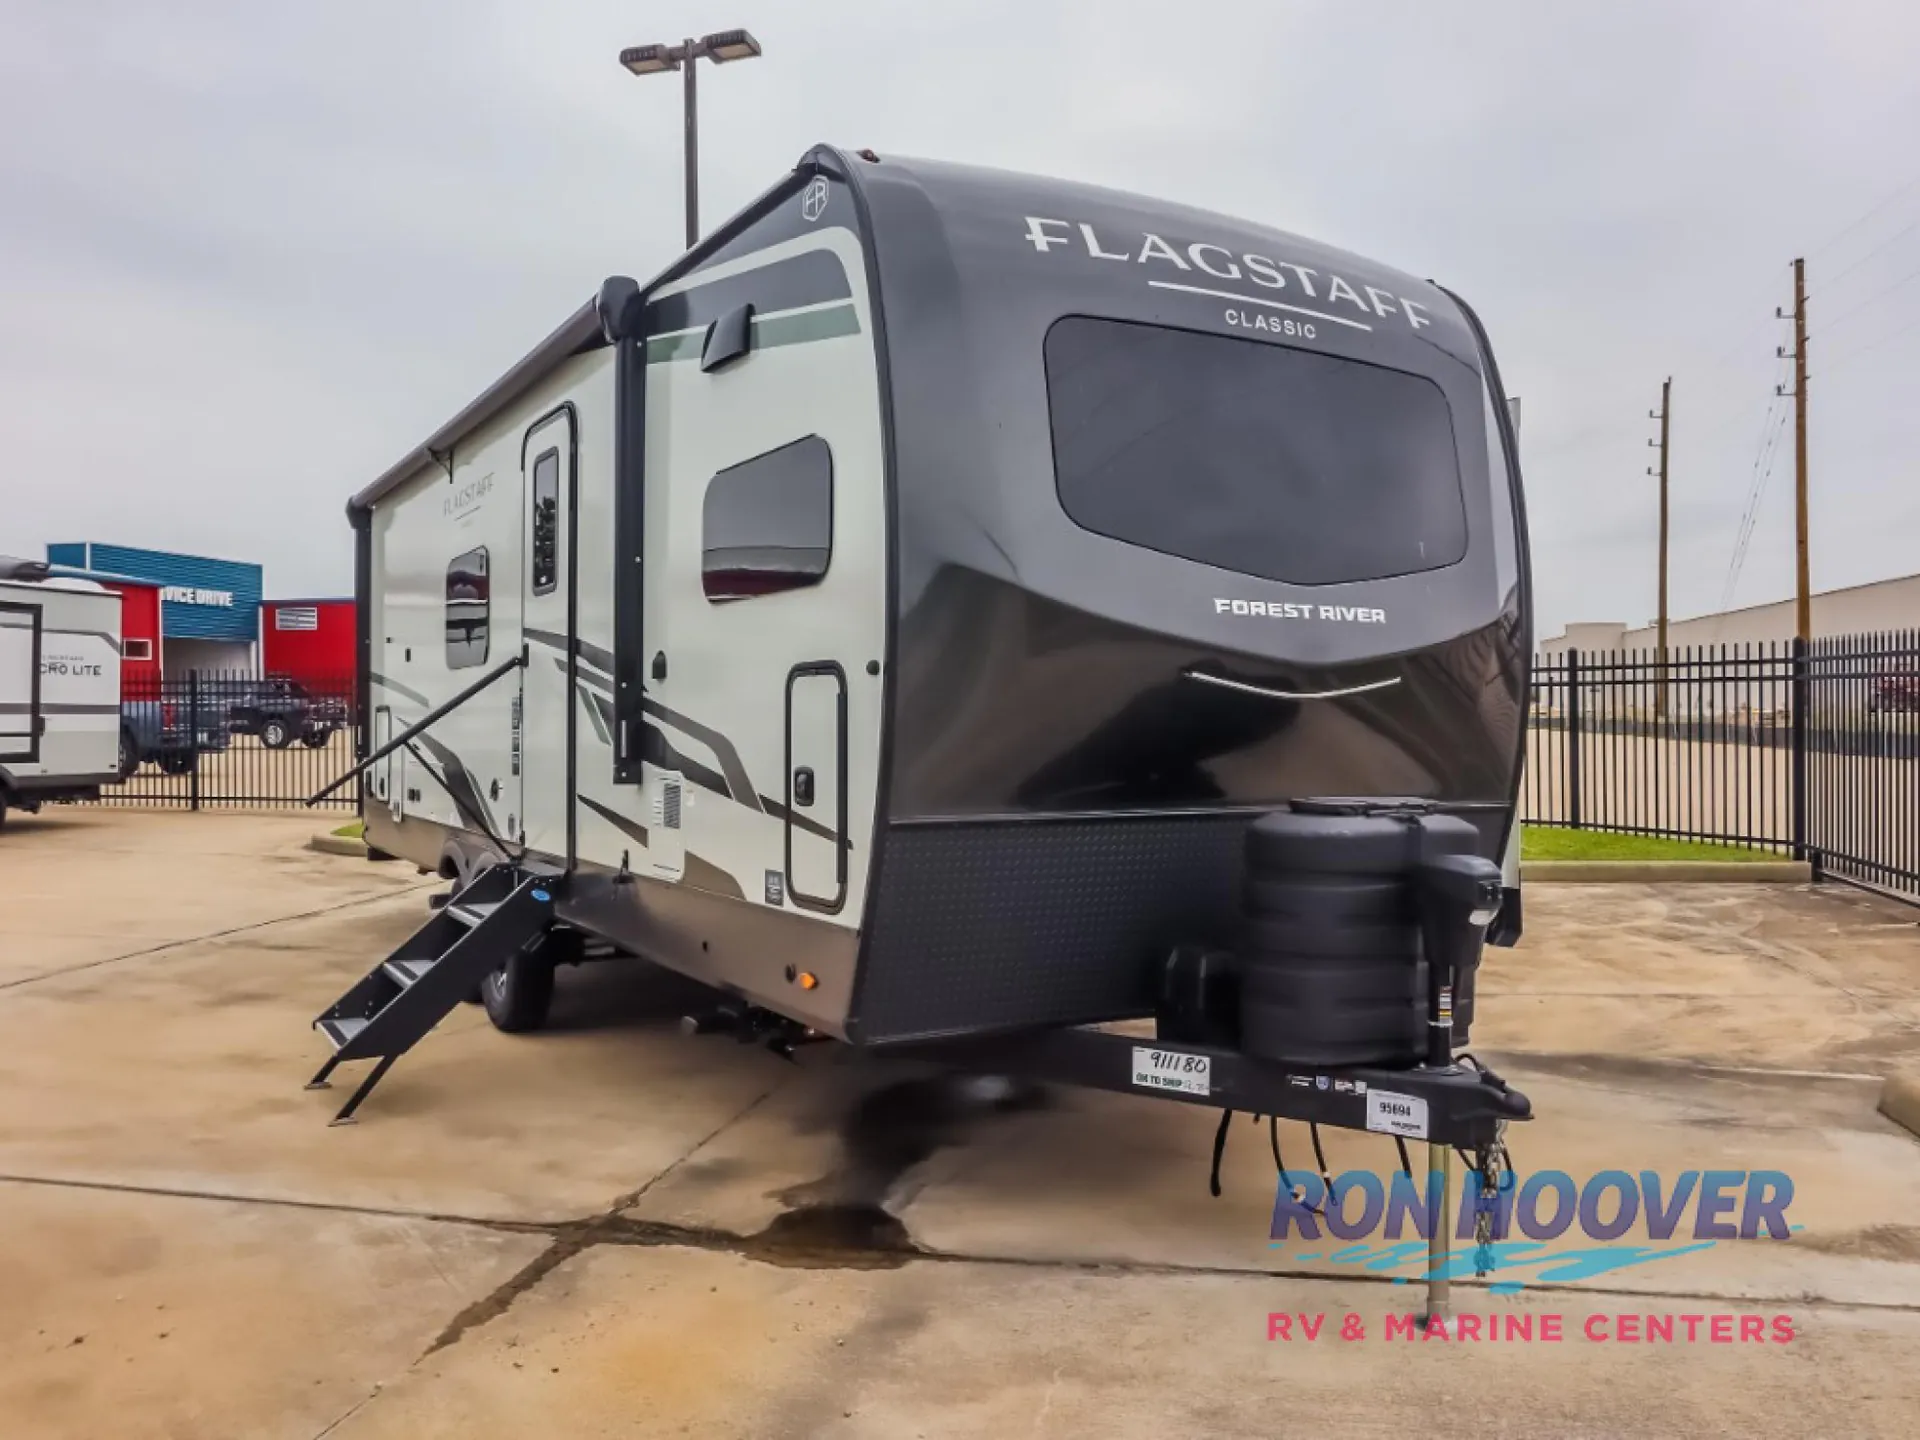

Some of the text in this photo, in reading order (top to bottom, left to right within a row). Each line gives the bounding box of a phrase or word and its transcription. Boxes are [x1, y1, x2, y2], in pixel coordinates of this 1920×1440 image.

[1025, 216, 1432, 330] FLAGSTAFF
[1225, 309, 1317, 339] CLASSIC
[196, 589, 234, 607] DRIVE
[1214, 598, 1387, 624] FOREST RIVER
[72, 664, 102, 676] LITE
